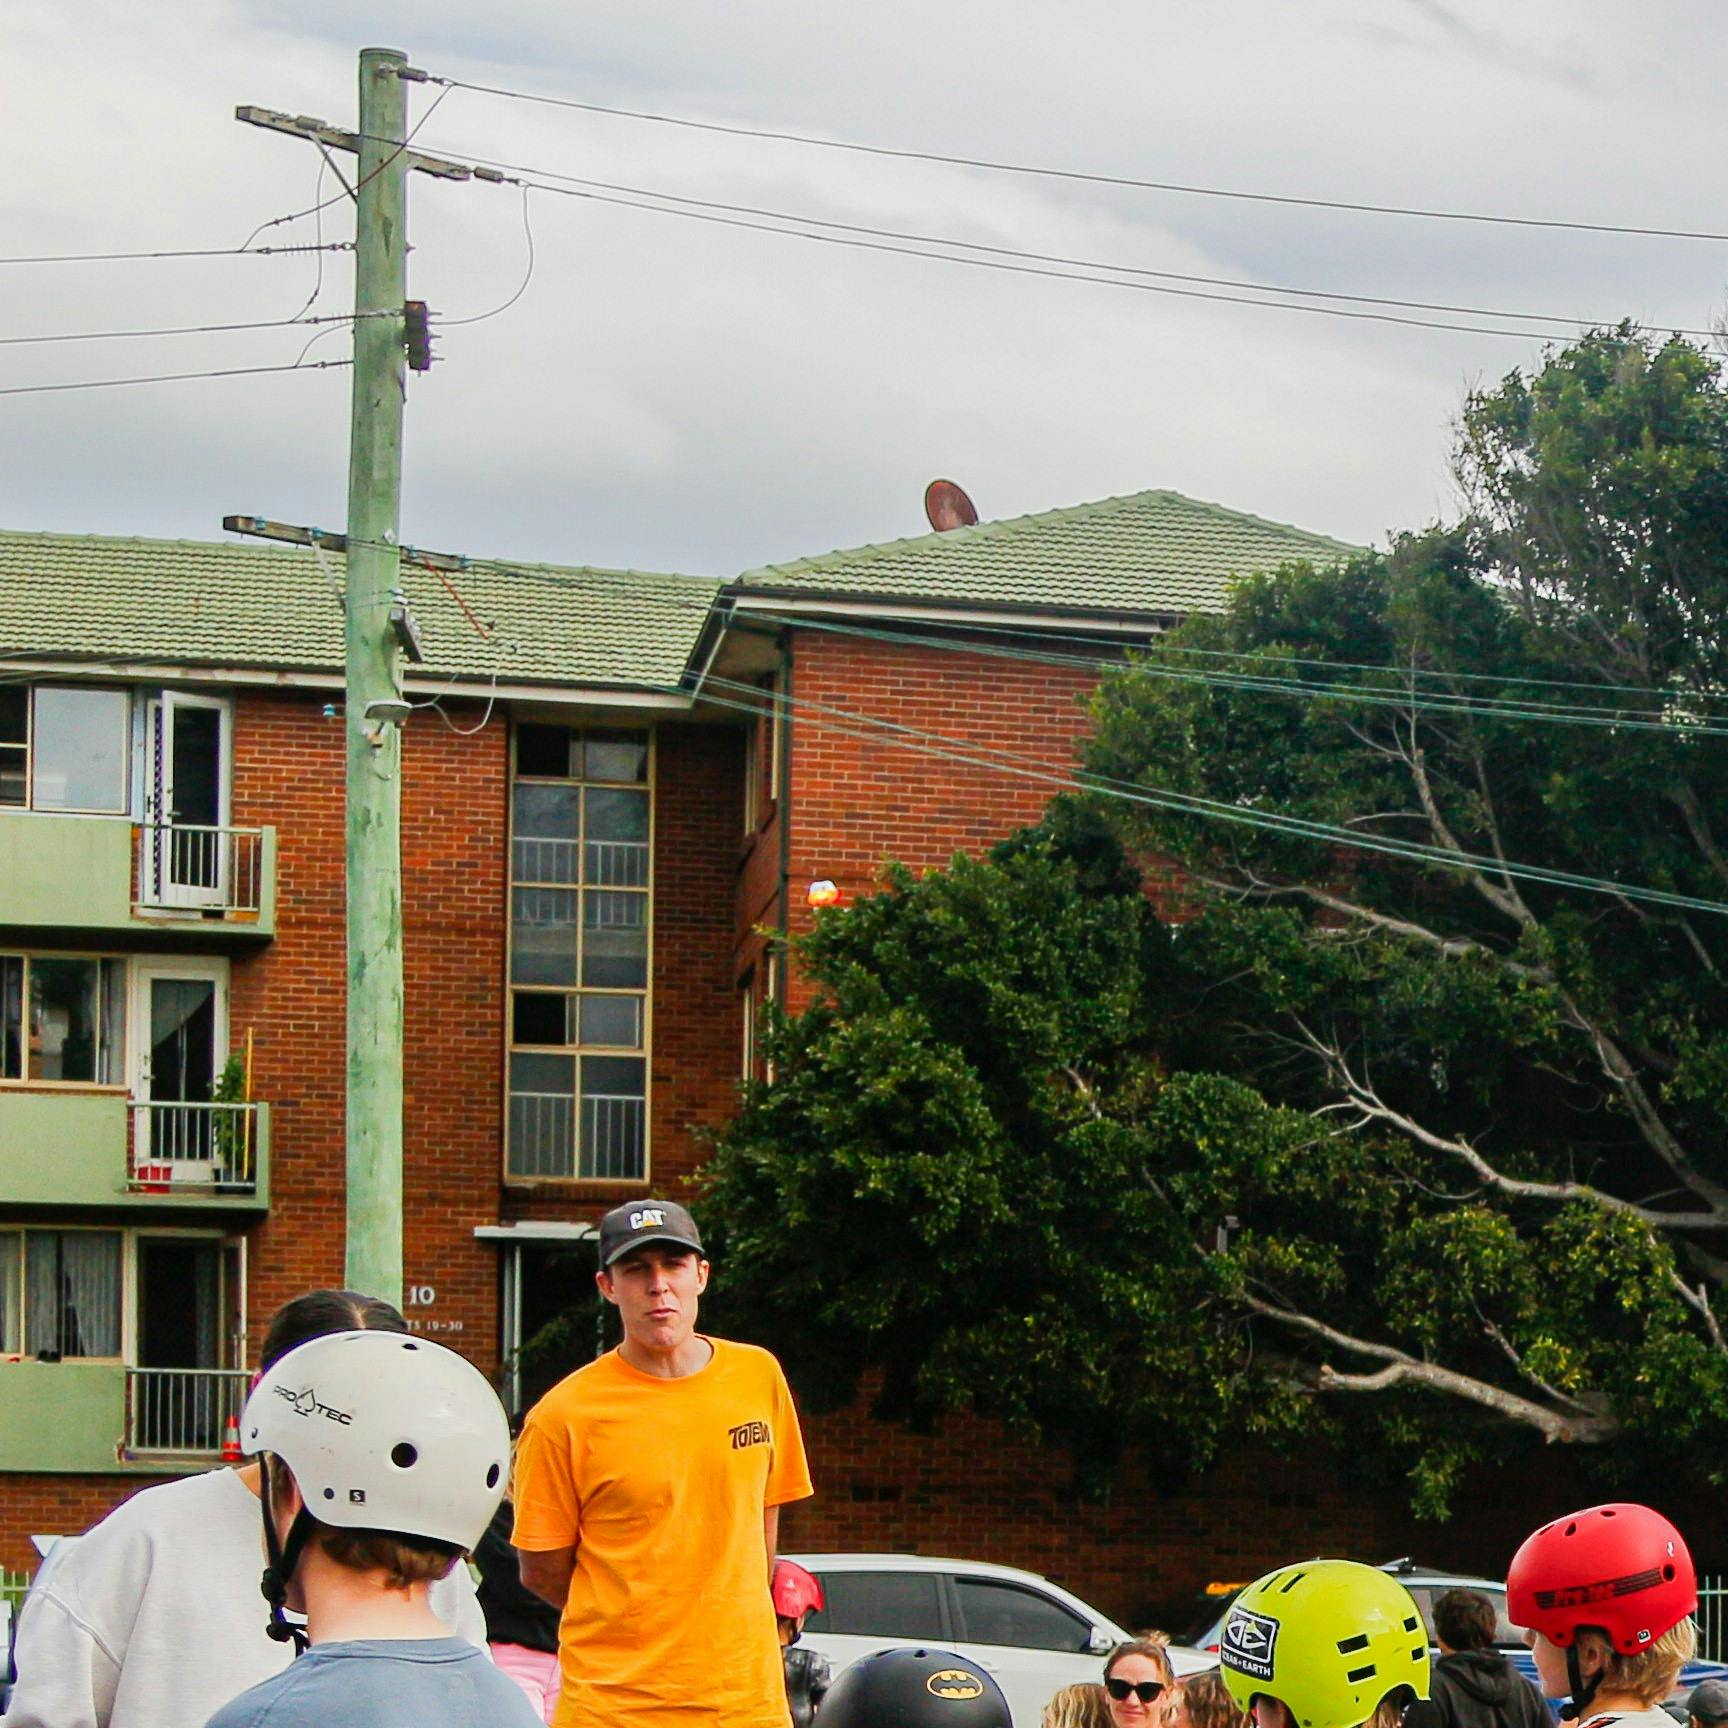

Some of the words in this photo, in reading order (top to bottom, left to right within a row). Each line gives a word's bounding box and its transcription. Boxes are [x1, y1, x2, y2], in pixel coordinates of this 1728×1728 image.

[629, 1209, 665, 1230] CAT
[409, 1285, 435, 1305] 10
[426, 1320, 463, 1331] 19-30
[274, 1385, 297, 1403] PRO
[316, 1403, 353, 1426] TEC
[728, 1420, 771, 1450] TOTEM
